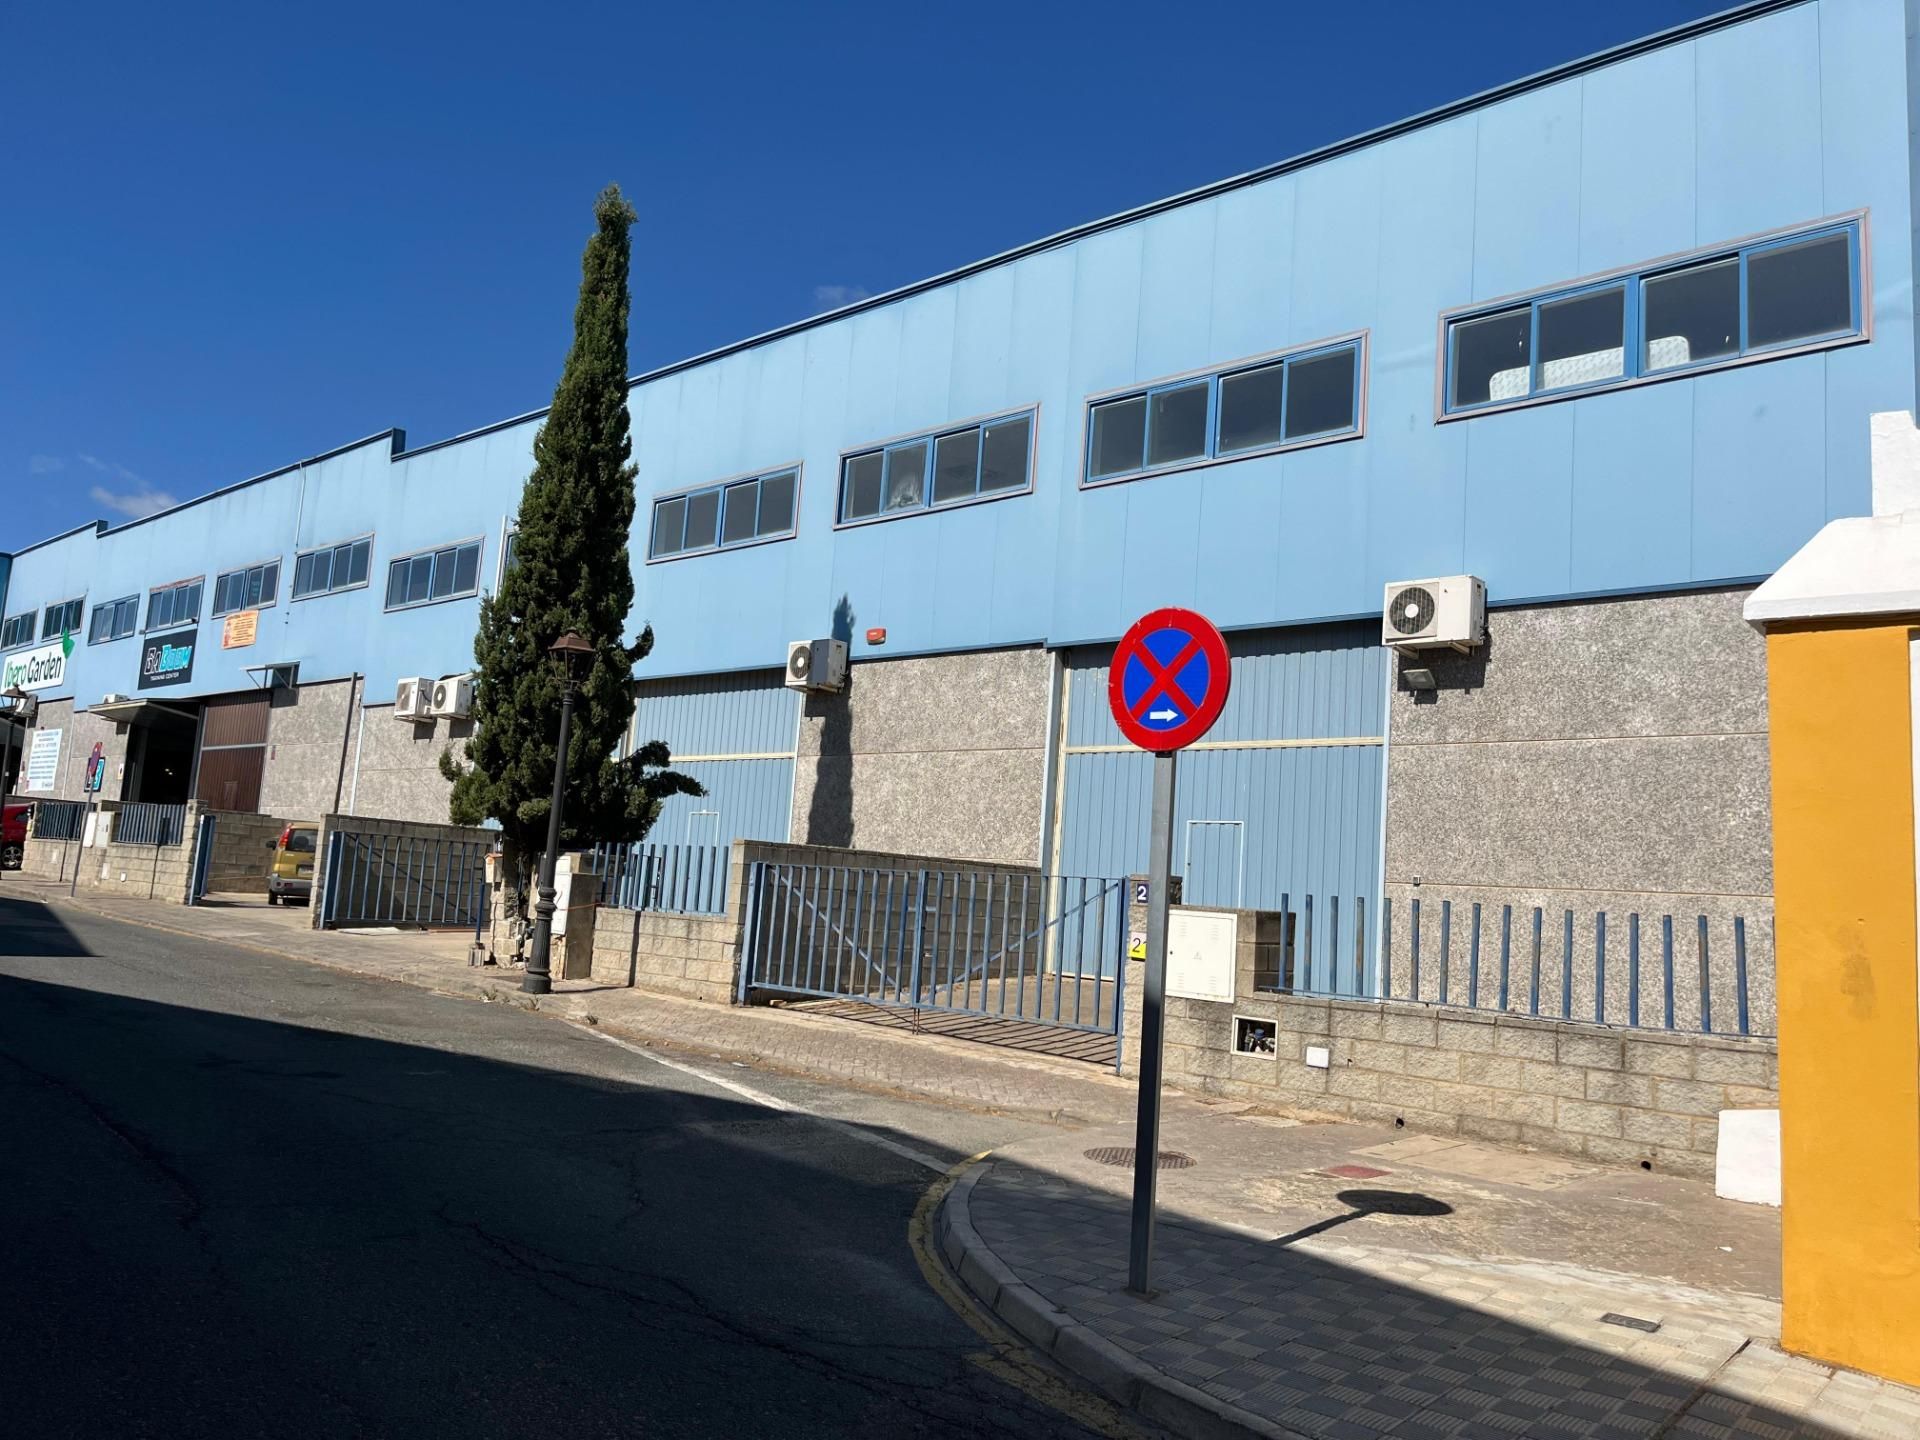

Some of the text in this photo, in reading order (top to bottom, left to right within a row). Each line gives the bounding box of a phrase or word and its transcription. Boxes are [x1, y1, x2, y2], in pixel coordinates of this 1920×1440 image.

[5, 651, 62, 688] Ibero Garden
[1132, 937, 1146, 953] 2
